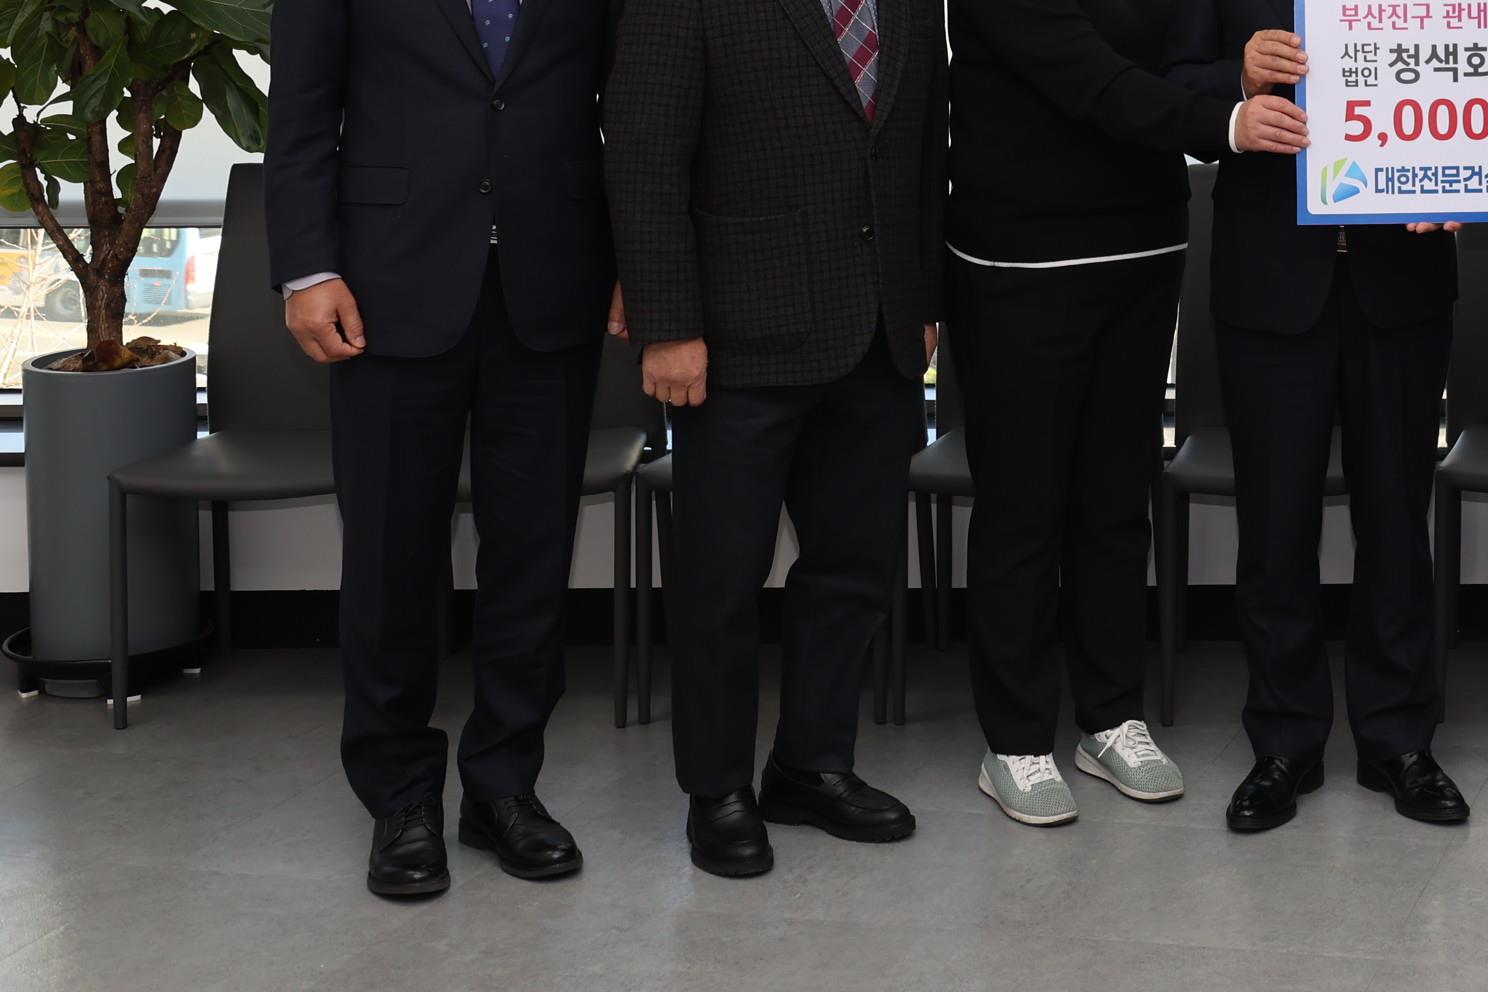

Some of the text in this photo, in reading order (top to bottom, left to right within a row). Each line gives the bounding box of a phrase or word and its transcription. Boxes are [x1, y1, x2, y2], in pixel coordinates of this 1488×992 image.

[1339, 4, 1434, 31] 부산진구
[1443, 2, 1488, 30] 관내
[1340, 42, 1380, 63] 사단
[1342, 66, 1379, 88] 법인
